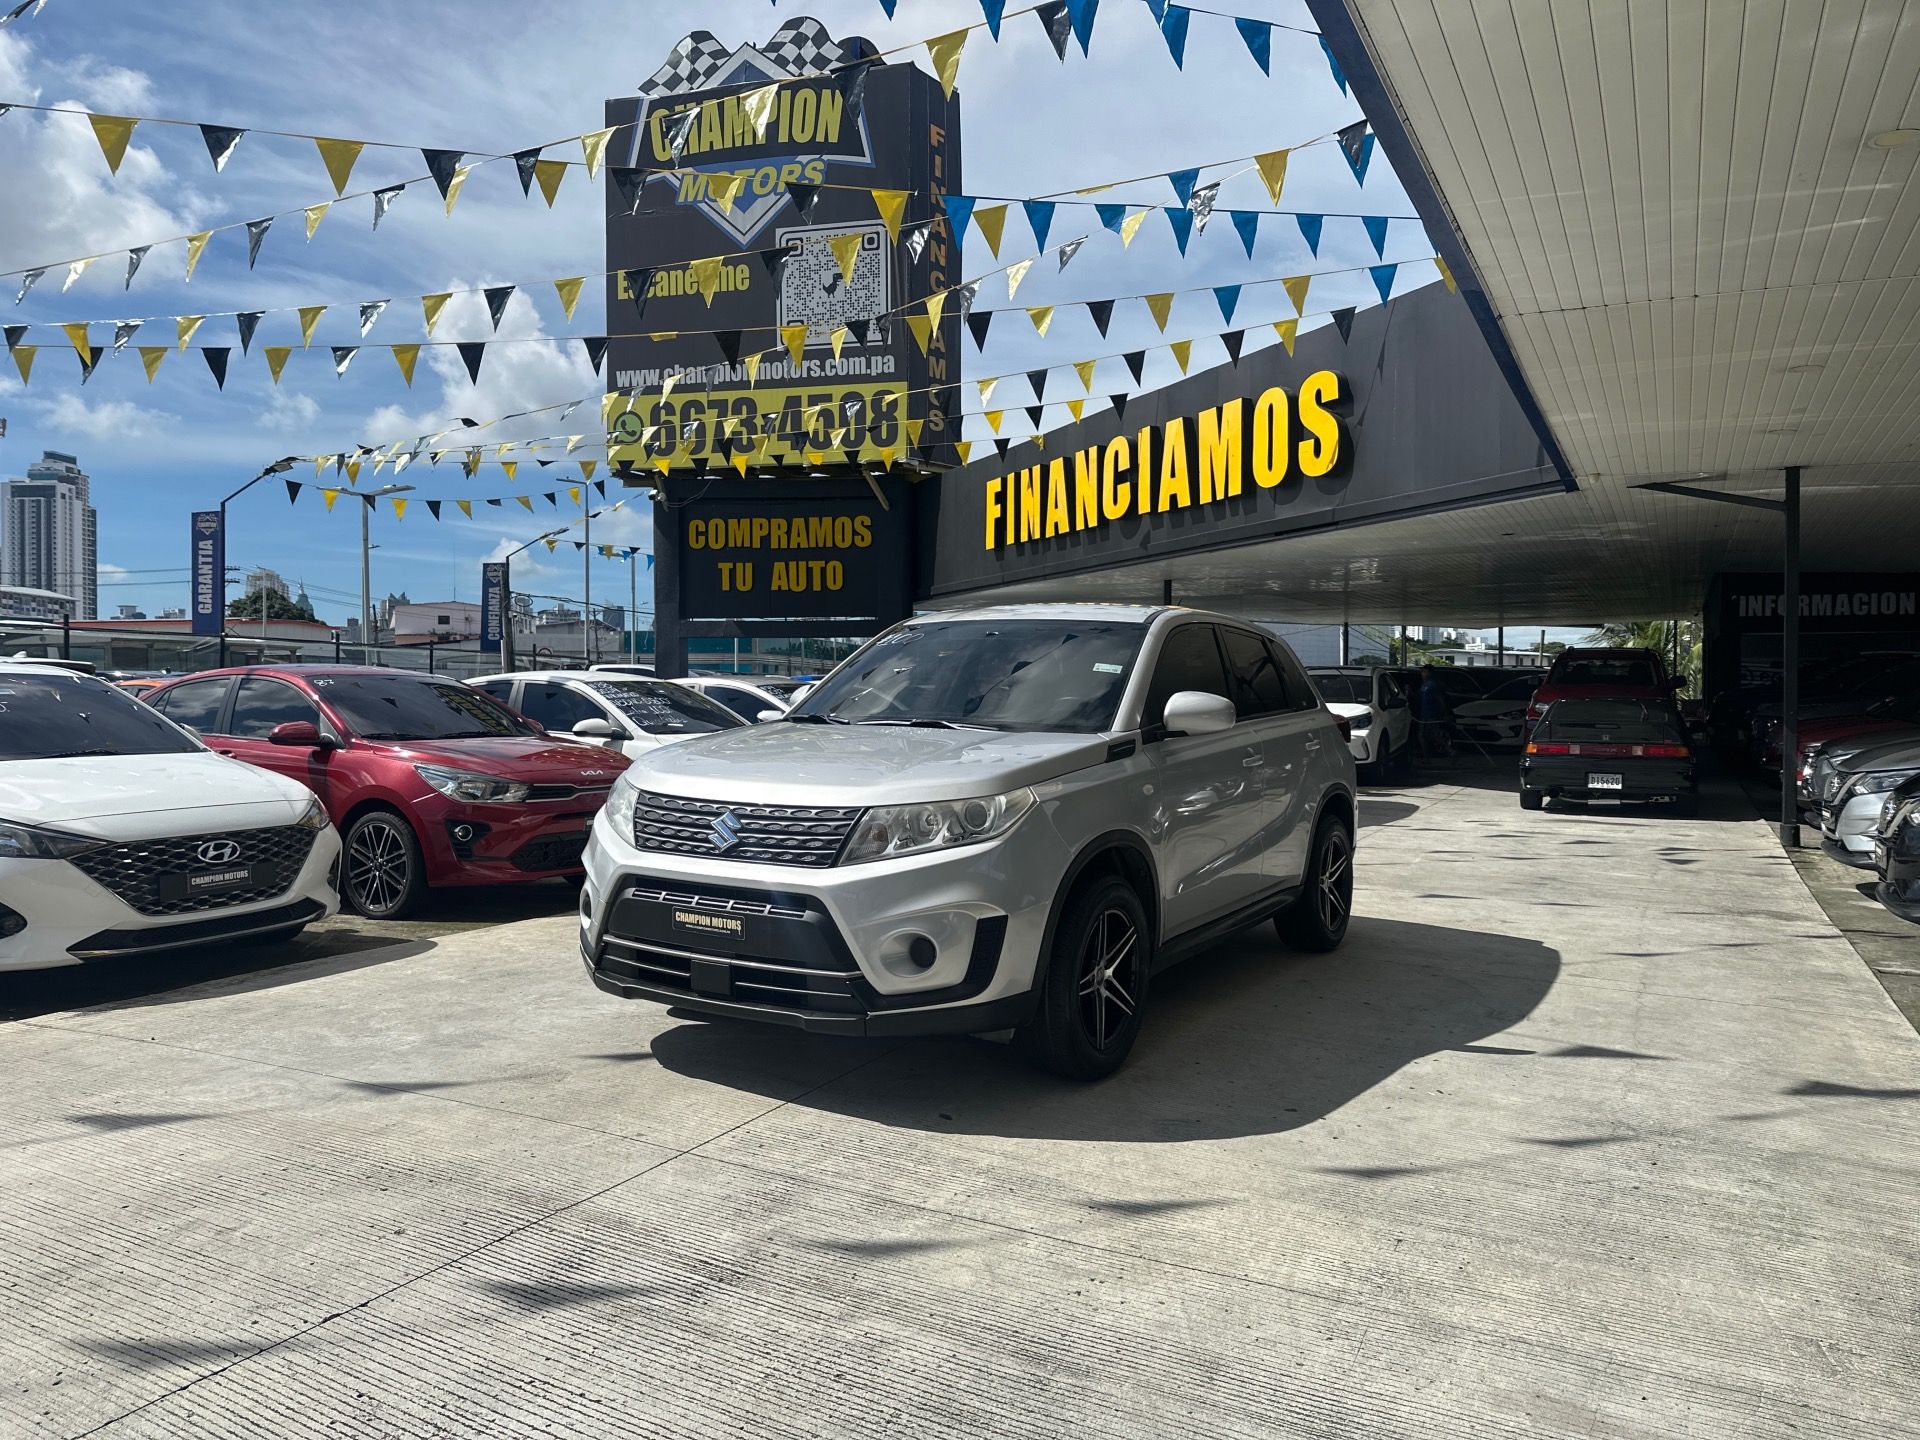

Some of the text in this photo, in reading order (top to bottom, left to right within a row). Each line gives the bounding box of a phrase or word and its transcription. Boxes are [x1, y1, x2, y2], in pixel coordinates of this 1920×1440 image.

[985, 369, 1340, 550] FINANCIAMOS
[688, 515, 872, 549] COMPRAMOS
[197, 539, 213, 614] GARANTIA
[717, 560, 844, 592] TU AUTO
[487, 586, 501, 641] CONFIANZA
[192, 873, 224, 885] CHAMPION
[224, 870, 248, 880] MOTORS
[675, 911, 711, 926] CHAMPION
[712, 917, 741, 931] MOTORS
